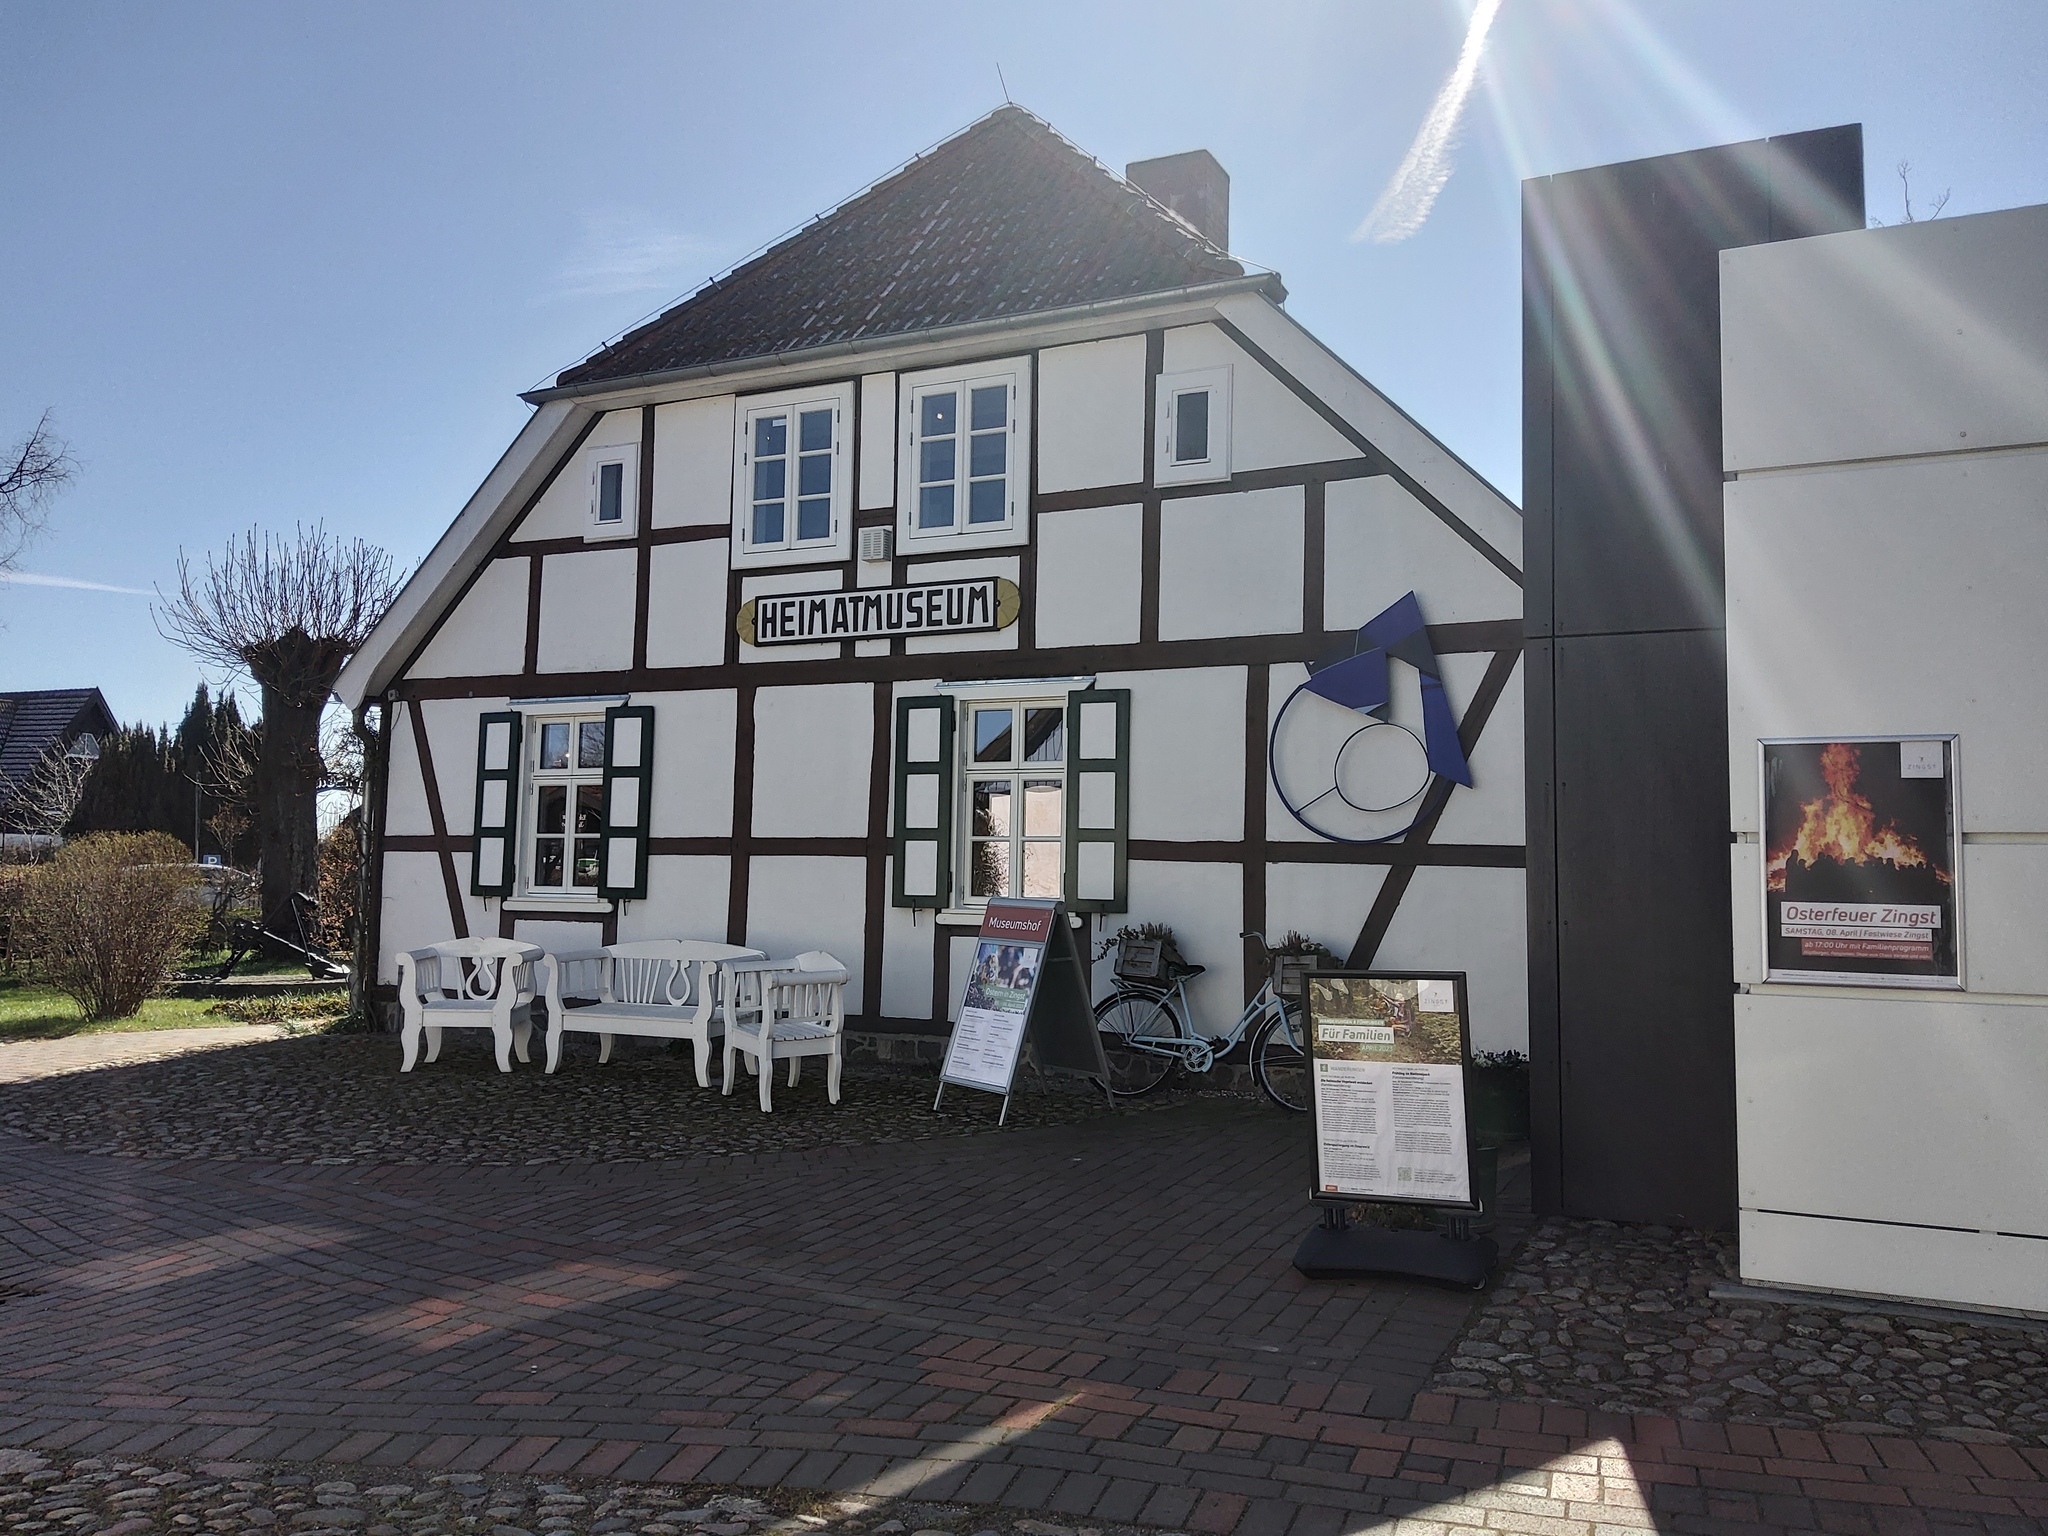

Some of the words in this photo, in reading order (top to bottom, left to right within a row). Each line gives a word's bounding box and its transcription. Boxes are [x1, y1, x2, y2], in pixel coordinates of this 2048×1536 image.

[761, 586, 989, 638] HEIMATMUSEUM
[1786, 906, 1877, 922] Osterfeuer
[1880, 908, 1937, 927] Zingst
[988, 916, 1042, 931] Museumshof
[1784, 927, 1824, 936] SAMSTAG,
[1839, 929, 1858, 937] April
[1863, 929, 1902, 938] Festwiese
[1903, 931, 1929, 940] Zingst
[1862, 943, 1930, 952] Familienprogramm
[985, 987, 1003, 997] Ostern
[1009, 991, 1026, 1000] Zingst
[1322, 1028, 1340, 1038] Für
[1342, 1029, 1391, 1040] Familien
